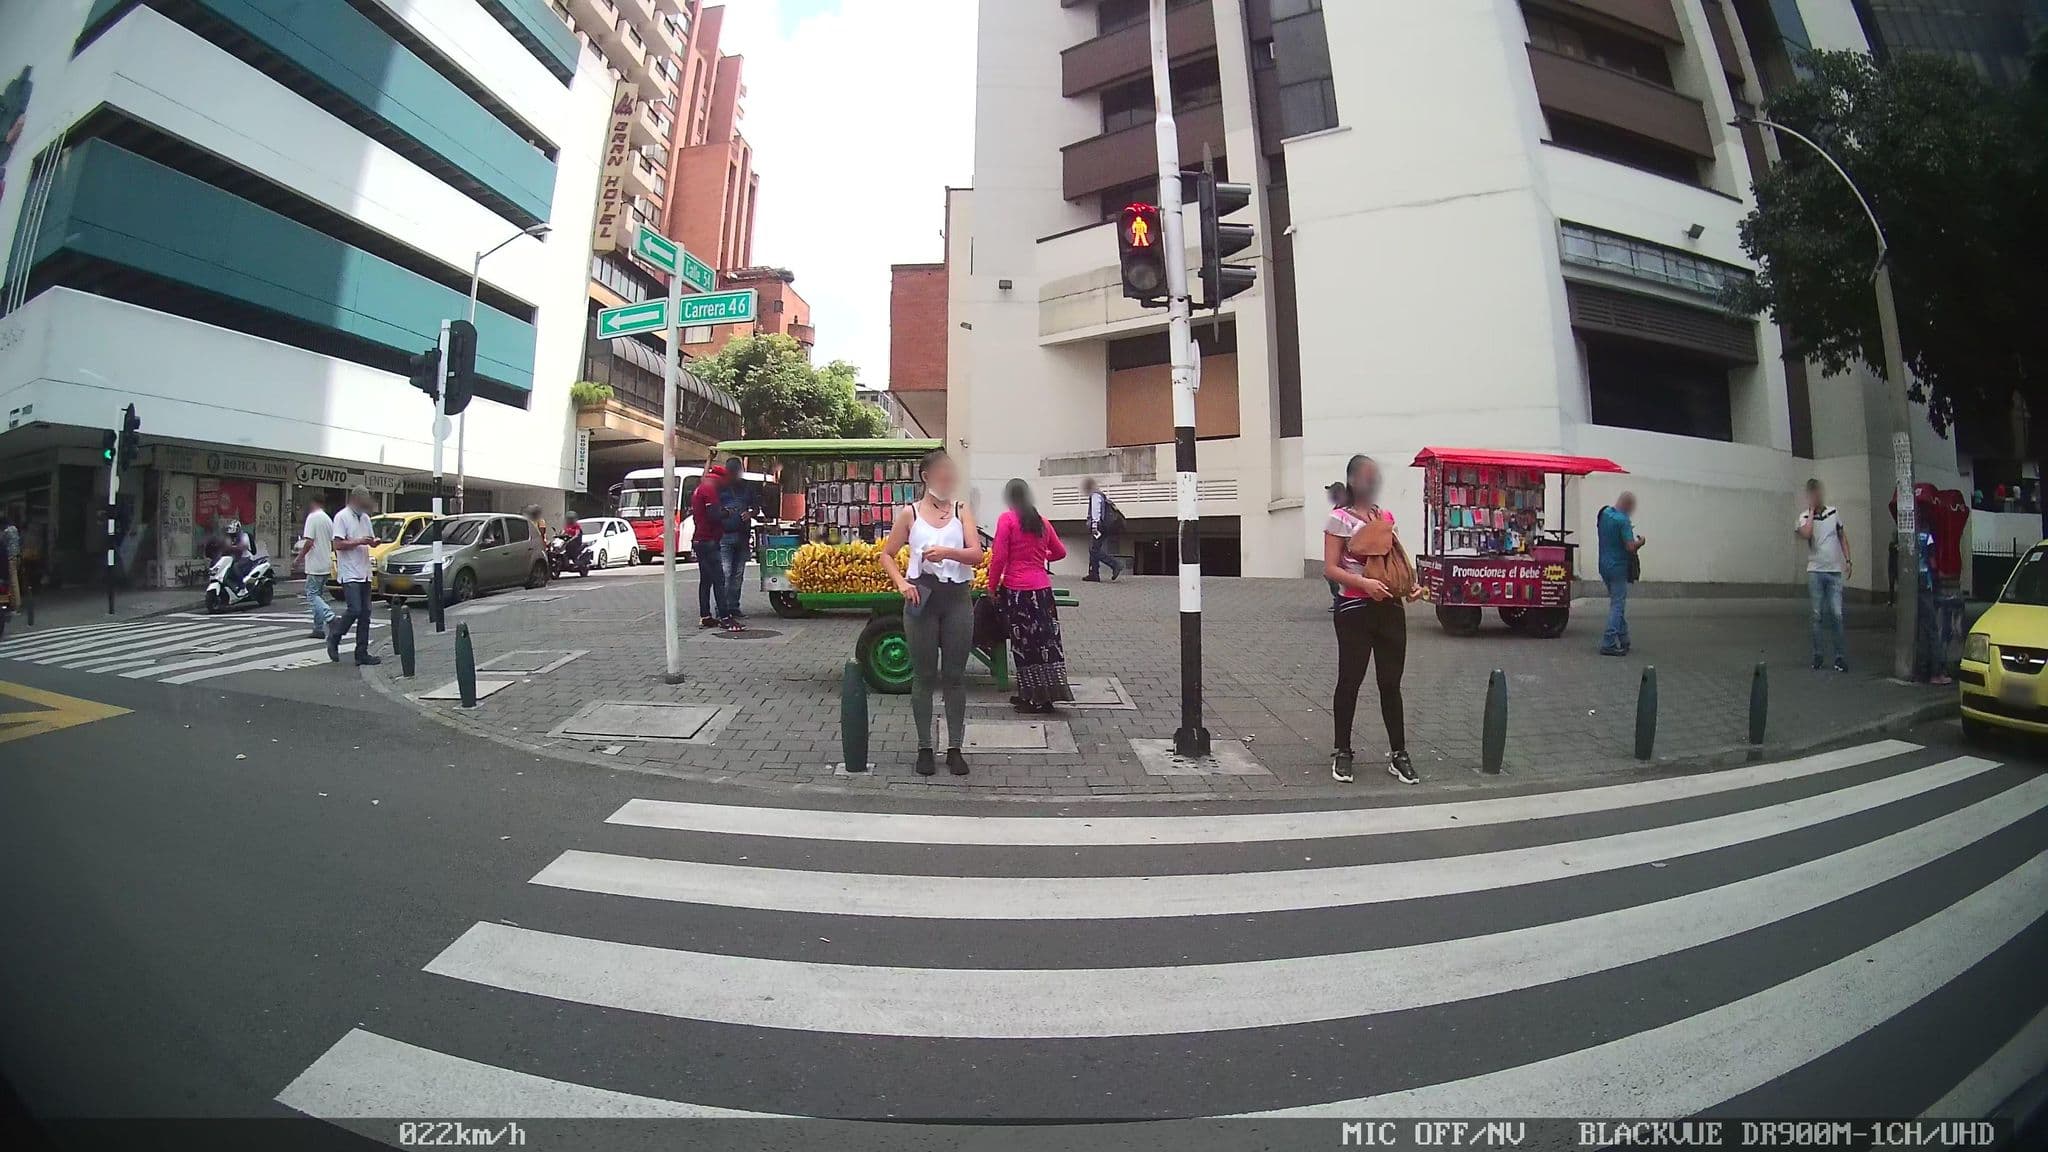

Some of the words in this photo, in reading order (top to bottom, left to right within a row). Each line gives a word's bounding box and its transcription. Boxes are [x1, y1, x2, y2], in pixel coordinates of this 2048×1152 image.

[607, 121, 628, 167] GRAN
[599, 175, 618, 238] HOTEL
[685, 259, 701, 283] Calle
[684, 301, 726, 319] Carrera
[728, 297, 747, 315] 46
[223, 458, 257, 473] BOTICA
[310, 467, 347, 483] PUNTO
[1452, 565, 1506, 578] Promociones
[1509, 566, 1517, 578] el
